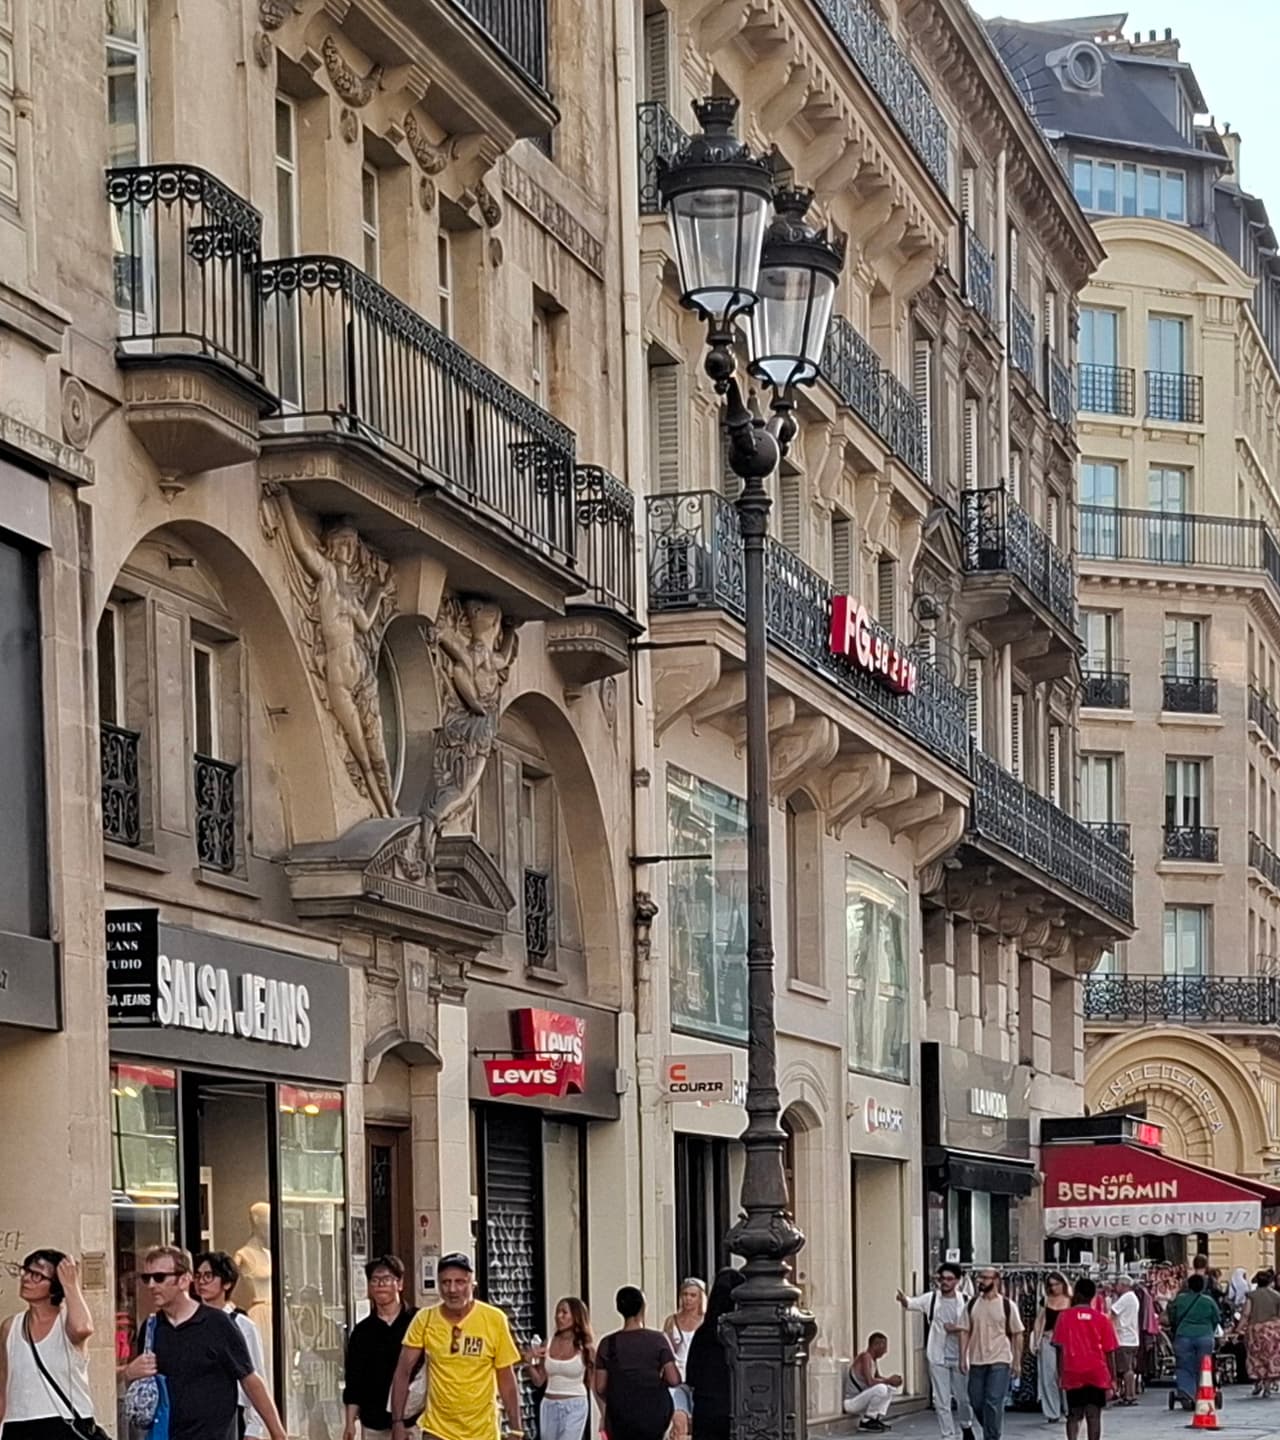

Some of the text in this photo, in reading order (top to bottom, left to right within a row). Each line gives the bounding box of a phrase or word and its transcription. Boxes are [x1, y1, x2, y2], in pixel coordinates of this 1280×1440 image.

[107, 921, 142, 932] OMEN
[107, 941, 139, 951] EANS
[120, 994, 151, 1006] JEANS
[157, 954, 311, 1049] SALSA JEANS
[669, 1082, 723, 1093] COURIR
[1101, 1172, 1134, 1185] CAFÉ
[1058, 1180, 1178, 1202] BENJAMIN
[1058, 1211, 1251, 1229] SERVICE CONTINU 7/7
